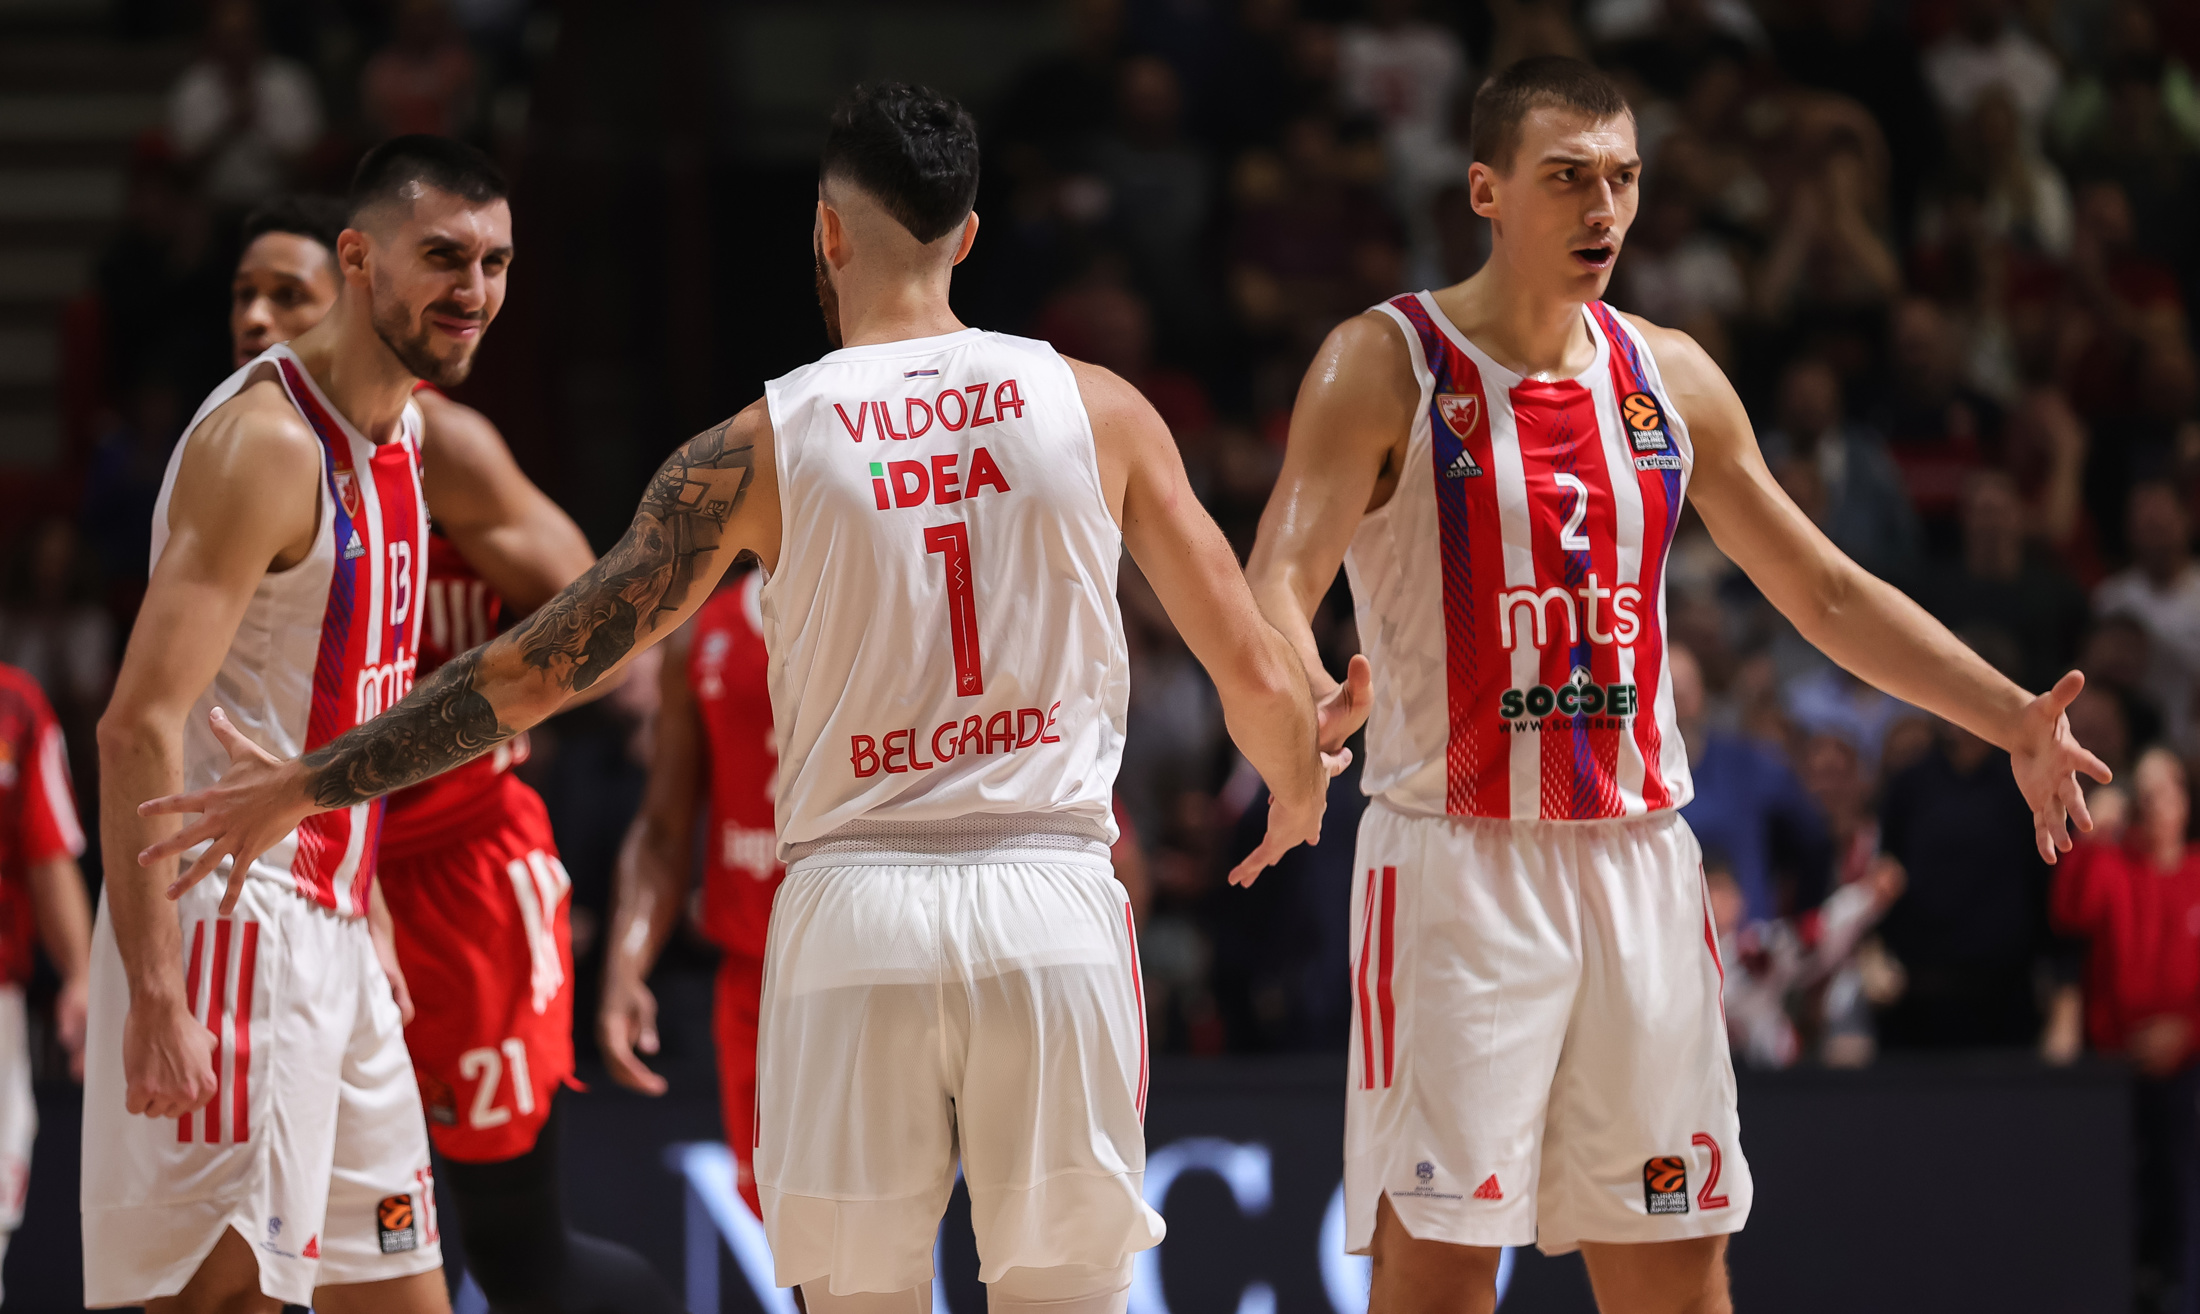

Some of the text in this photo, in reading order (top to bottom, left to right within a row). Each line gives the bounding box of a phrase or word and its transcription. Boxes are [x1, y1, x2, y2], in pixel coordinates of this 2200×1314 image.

[833, 379, 1025, 443] VILDOZA
[1446, 466, 1483, 479] adidas
[1553, 472, 1591, 550] 2
[389, 540, 411, 626] 13
[923, 521, 984, 698] 1
[1498, 572, 1643, 648] mts
[850, 700, 1062, 779] BELGRADE
[458, 1036, 536, 1131] 21
[1691, 1131, 1730, 1211] 2
